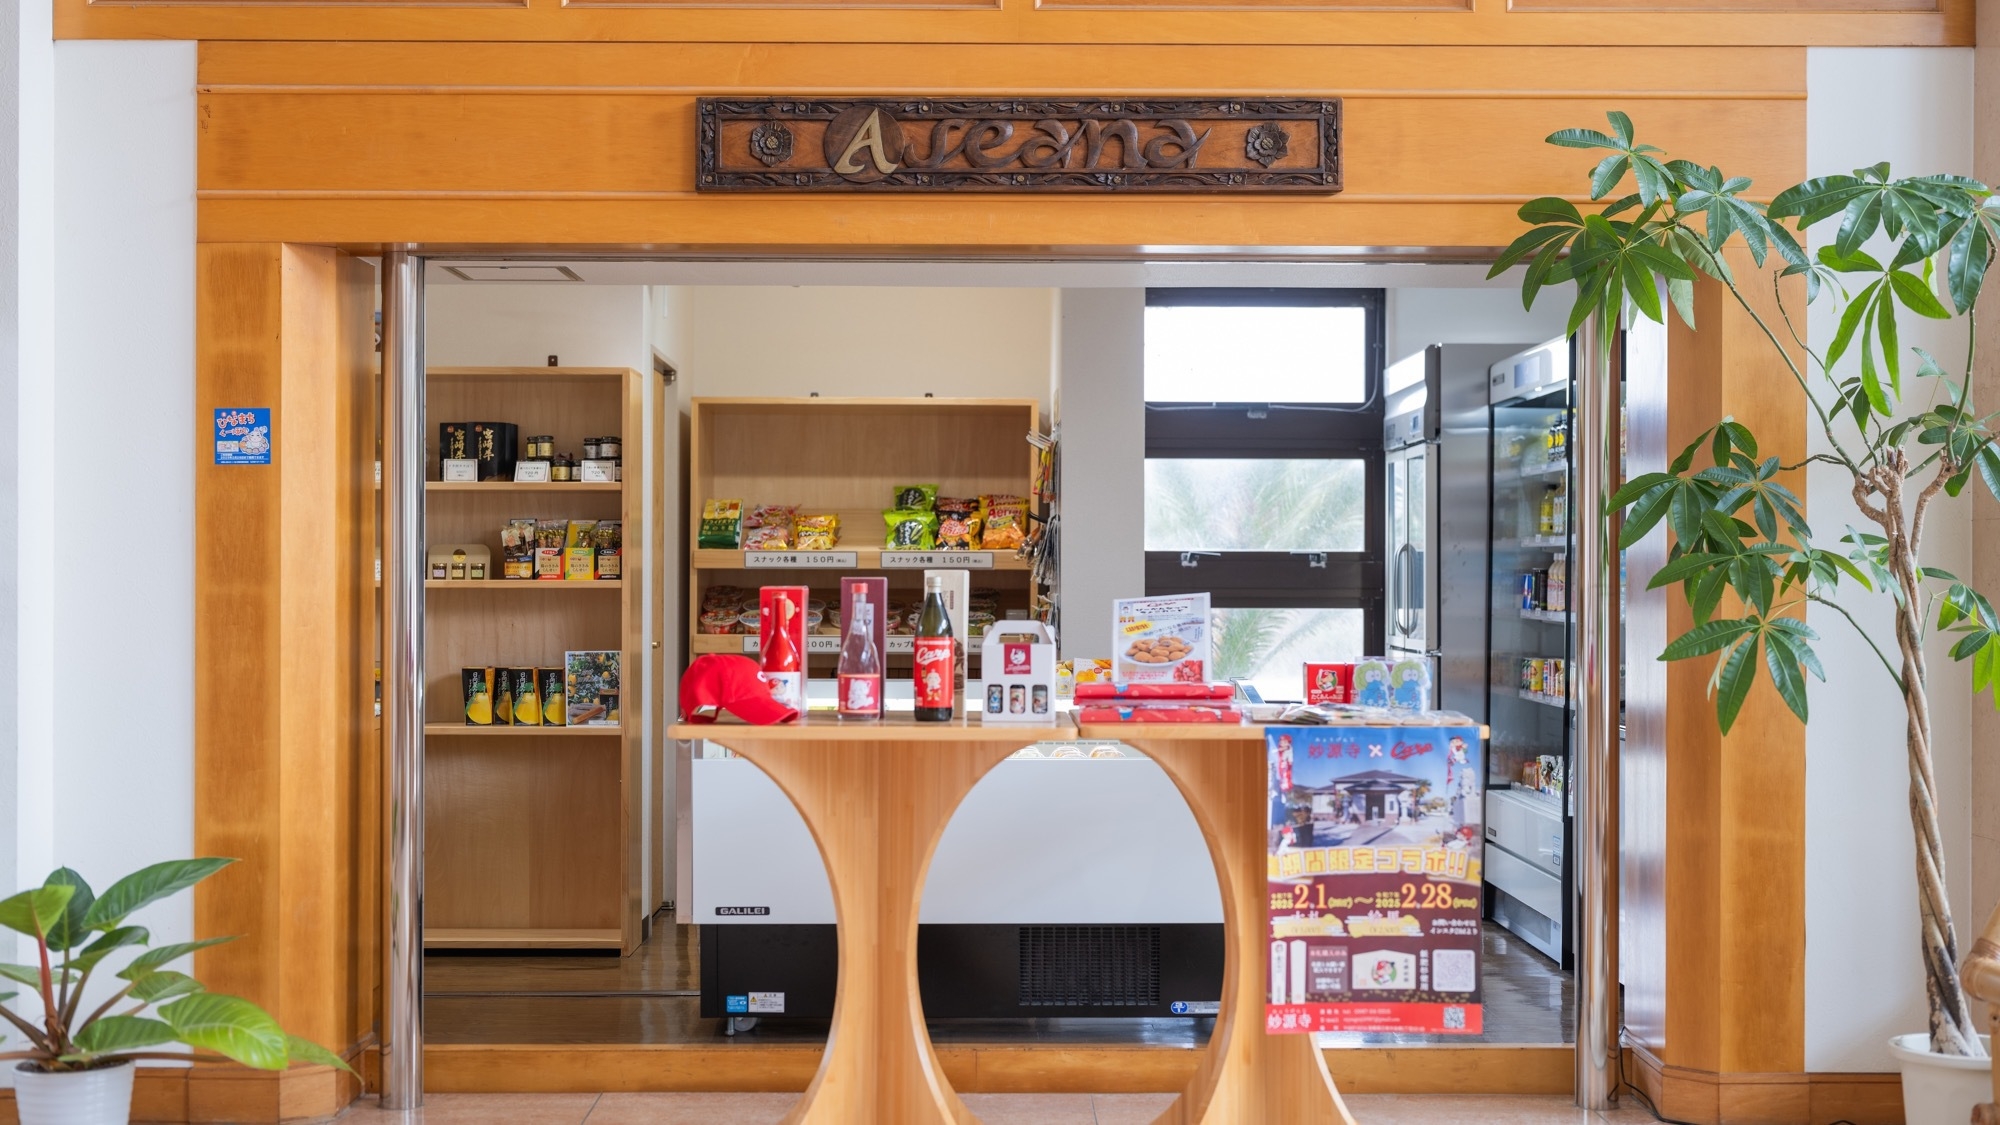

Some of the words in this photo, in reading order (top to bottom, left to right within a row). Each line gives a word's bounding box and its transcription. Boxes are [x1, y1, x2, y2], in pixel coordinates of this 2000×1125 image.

[916, 647, 950, 665] Carp
[1308, 743, 1361, 760] 妙源寺
[1281, 847, 1466, 878] 期間限定コラボ!!
[1401, 883, 1452, 910] 2.28
